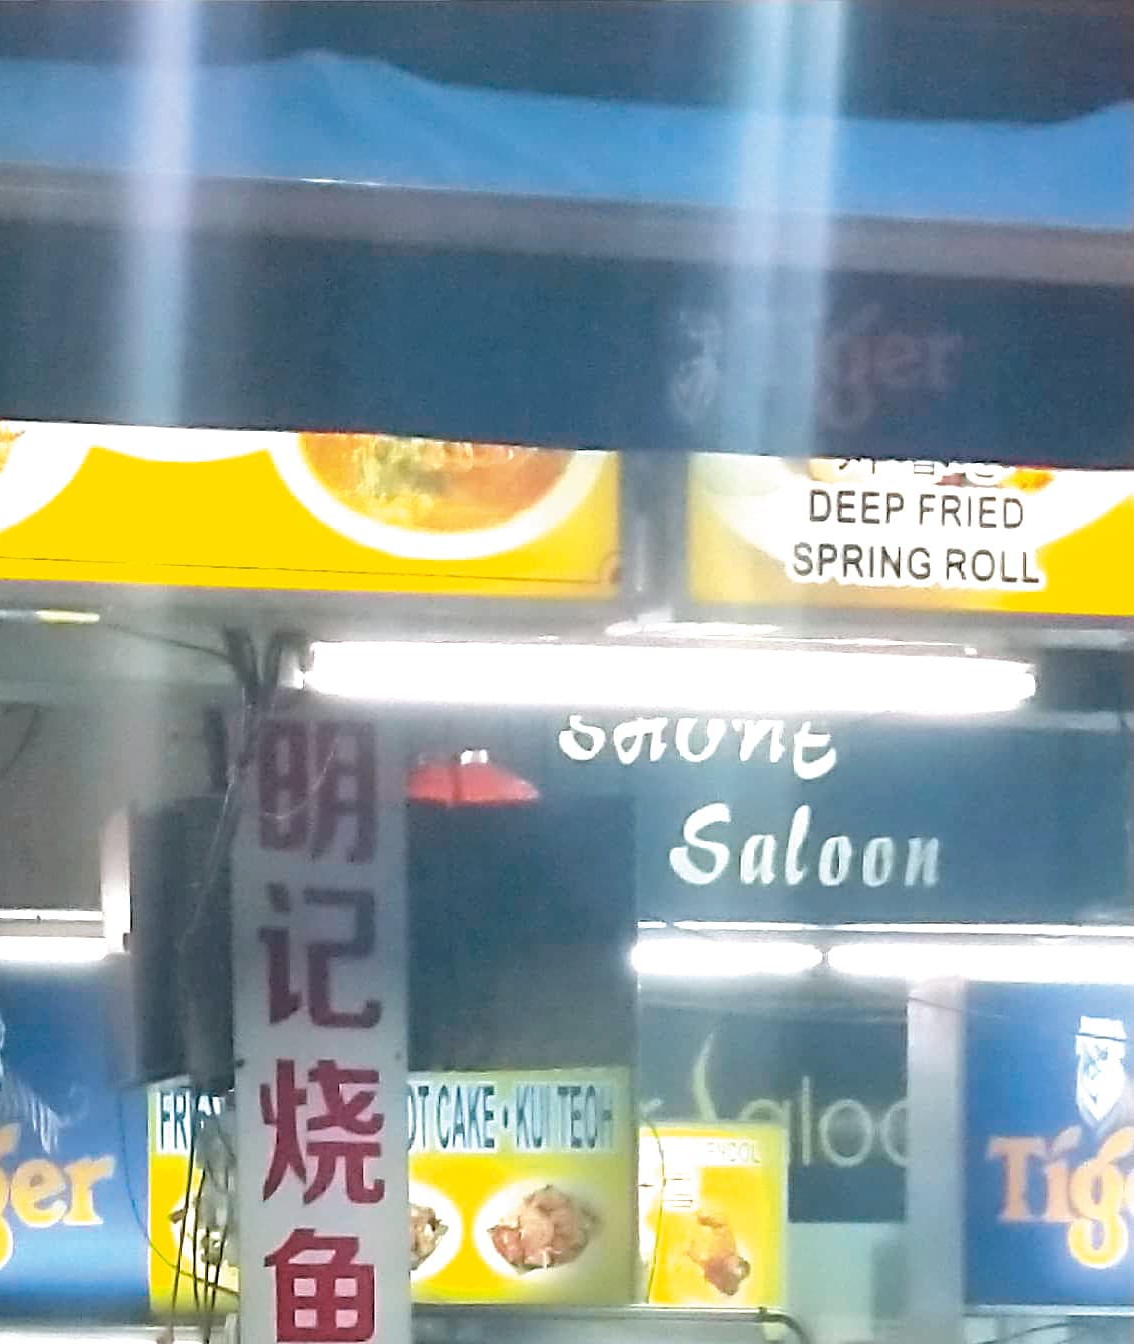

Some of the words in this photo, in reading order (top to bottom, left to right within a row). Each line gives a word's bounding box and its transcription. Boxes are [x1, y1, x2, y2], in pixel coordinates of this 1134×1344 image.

[809, 489, 904, 525] DEEP
[919, 493, 1024, 529] FRIED
[792, 541, 932, 581] SPRING
[946, 548, 1040, 584] ROLL
[669, 802, 940, 886] Saloon
[437, 1085, 496, 1149] CAKE
[985, 1124, 1134, 1270] Tig
